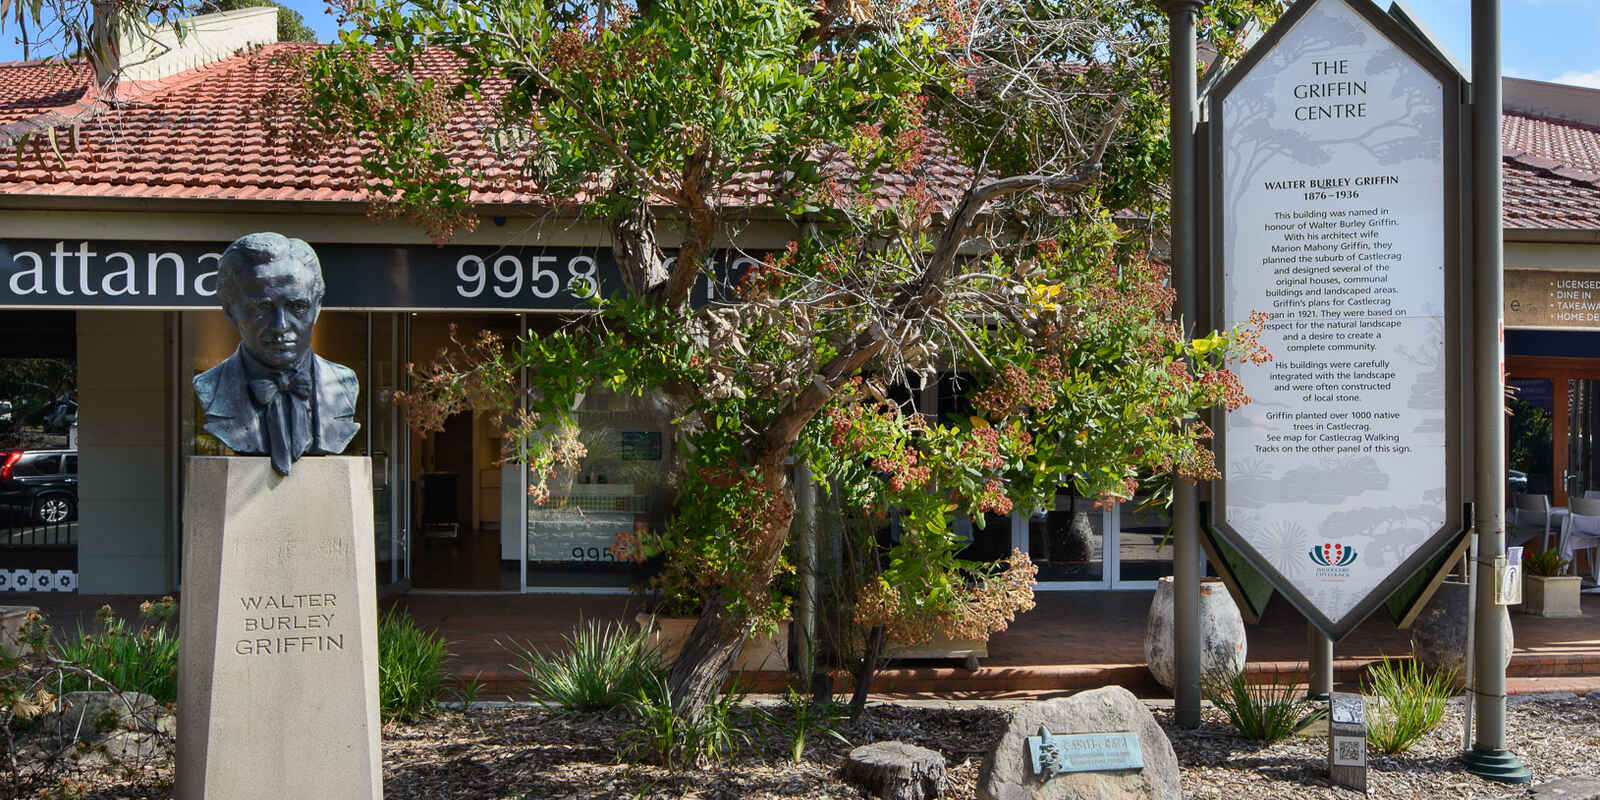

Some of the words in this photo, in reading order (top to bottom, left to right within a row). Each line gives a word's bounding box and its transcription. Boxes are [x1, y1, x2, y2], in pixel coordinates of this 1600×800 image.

[1312, 60, 1349, 76] THE
[1294, 81, 1367, 99] GRIFFIN
[1295, 103, 1367, 121] CENTRE
[1265, 181, 1306, 190] WALTER
[1310, 178, 1350, 189] BURLEY
[1355, 176, 1398, 186] GRIFFIN
[1274, 212, 1291, 220] This
[1293, 210, 1327, 220] building
[1330, 210, 1347, 218] was
[1348, 207, 1378, 217] named
[1381, 208, 1389, 216] in
[1265, 222, 1296, 232] honour
[1297, 222, 1308, 231] of
[1309, 221, 1337, 229] Walter
[1339, 220, 1366, 229] Burley
[1368, 218, 1399, 228] Griffin.
[1284, 233, 1305, 242] With
[1306, 232, 1319, 241] his
[1321, 231, 1357, 240] architect
[1359, 230, 1379, 239] wife
[1272, 244, 1301, 253] Marion
[1303, 243, 1338, 253] Mahony
[1340, 242, 1371, 251] Griffin,
[1373, 241, 1393, 251] they
[1263, 255, 1297, 266] planned
[1298, 254, 1313, 264] the
[1314, 253, 1344, 263] suburb
[1346, 253, 1356, 261] of
[1358, 252, 1402, 262] Castlecrag
[1274, 266, 1290, 275] and
[1291, 265, 1330, 276] designed
[1332, 264, 1361, 273] several
[1363, 264, 1373, 272] of
[1375, 263, 1389, 272] the
[456, 255, 598, 298] 9958
[1275, 277, 1307, 288] original
[1310, 276, 1341, 286] houses,
[1343, 274, 1387, 284] communal
[1266, 288, 1304, 299] buildings
[1305, 287, 1322, 296] and
[1323, 286, 1372, 297] landscaped
[1557, 291, 1579, 299] DINE
[1582, 291, 1592, 299] IN
[1308, 298, 1331, 308] plans
[1332, 298, 1345, 307] for
[1347, 297, 1391, 307] Castlecrag
[1270, 312, 1285, 321] gan
[1286, 310, 1295, 319] in
[1298, 310, 1318, 319] 1921.
[1320, 309, 1341, 320] They
[1367, 308, 1392, 317] based
[1394, 308, 1407, 316] on
[1557, 312, 1584, 320] HOME
[1263, 323, 1293, 331] respect
[1295, 321, 1308, 330] for
[1310, 321, 1325, 330] the
[1327, 320, 1357, 329] natural
[1360, 319, 1402, 329] landscape
[1282, 332, 1299, 342] and
[1300, 333, 1307, 341] a
[1309, 332, 1334, 341] desire
[1347, 332, 1373, 340] create
[1286, 343, 1326, 352] complete
[1327, 343, 1376, 352] community.
[1276, 361, 1288, 370] His
[1290, 361, 1328, 371] buildings
[1330, 361, 1352, 369] were
[1353, 360, 1389, 369] carefully
[1270, 372, 1313, 382] integrated
[1315, 371, 1335, 380] with
[1336, 371, 1351, 380] the
[1354, 371, 1395, 381] landscape
[1274, 382, 1291, 392] and
[1292, 383, 1313, 391] were
[1316, 383, 1339, 391] often
[1341, 382, 1391, 391] constructed
[1303, 394, 1312, 402] of
[1314, 393, 1334, 402] local
[1266, 411, 1293, 420] Griffin
[1295, 411, 1327, 421] planted
[1329, 412, 1349, 420] over
[1351, 410, 1372, 420] 1000
[1373, 410, 1400, 419] native
[1293, 423, 1314, 431] trees
[1316, 422, 1324, 431] in
[1326, 422, 1371, 433] Castlecrag.
[1283, 434, 1302, 444] map
[1304, 433, 1317, 442] for
[1319, 433, 1362, 443] Castlecrag
[1364, 433, 1399, 443] Walking
[1255, 445, 1279, 453] Tracks
[1295, 444, 1310, 453] the
[1312, 444, 1335, 453] other
[1337, 445, 1360, 454] panel
[1363, 444, 1372, 452] of
[1375, 445, 1390, 453] this
[1392, 444, 1412, 455] sign.
[240, 593, 337, 610] WALTER
[245, 614, 336, 632] BURLEY
[235, 634, 344, 655] GRIFFIN
